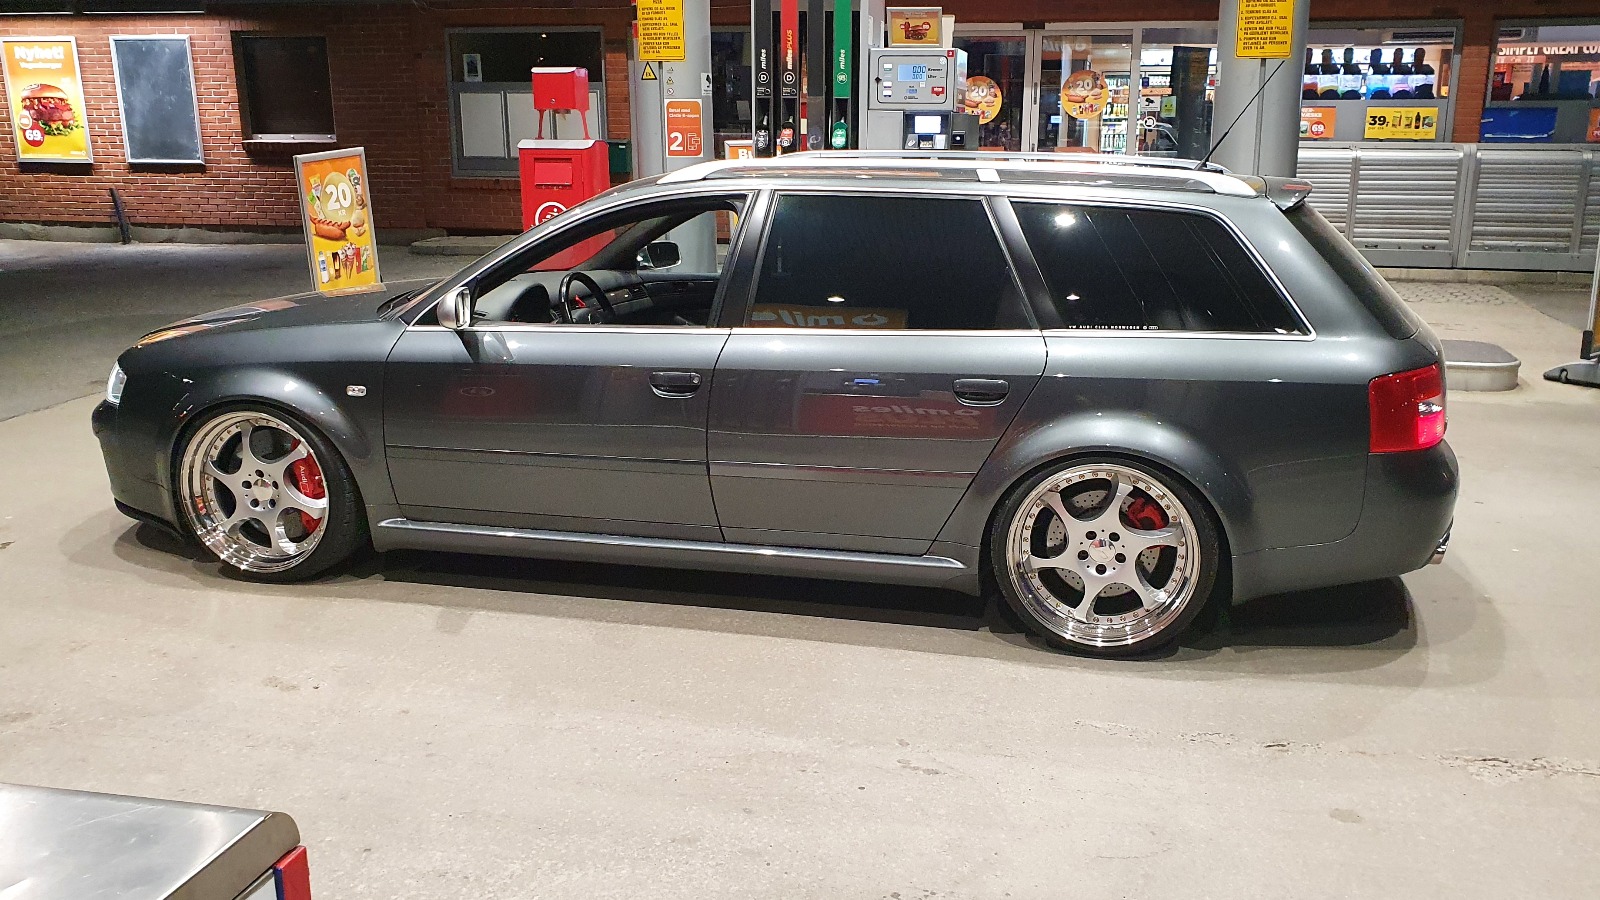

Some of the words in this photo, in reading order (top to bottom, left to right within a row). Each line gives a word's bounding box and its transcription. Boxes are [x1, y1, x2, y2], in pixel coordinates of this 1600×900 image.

[759, 48, 767, 70] miles
[971, 86, 987, 97] 20
[1076, 79, 1093, 91] 20
[669, 131, 684, 151] 2
[324, 182, 351, 211] 20
